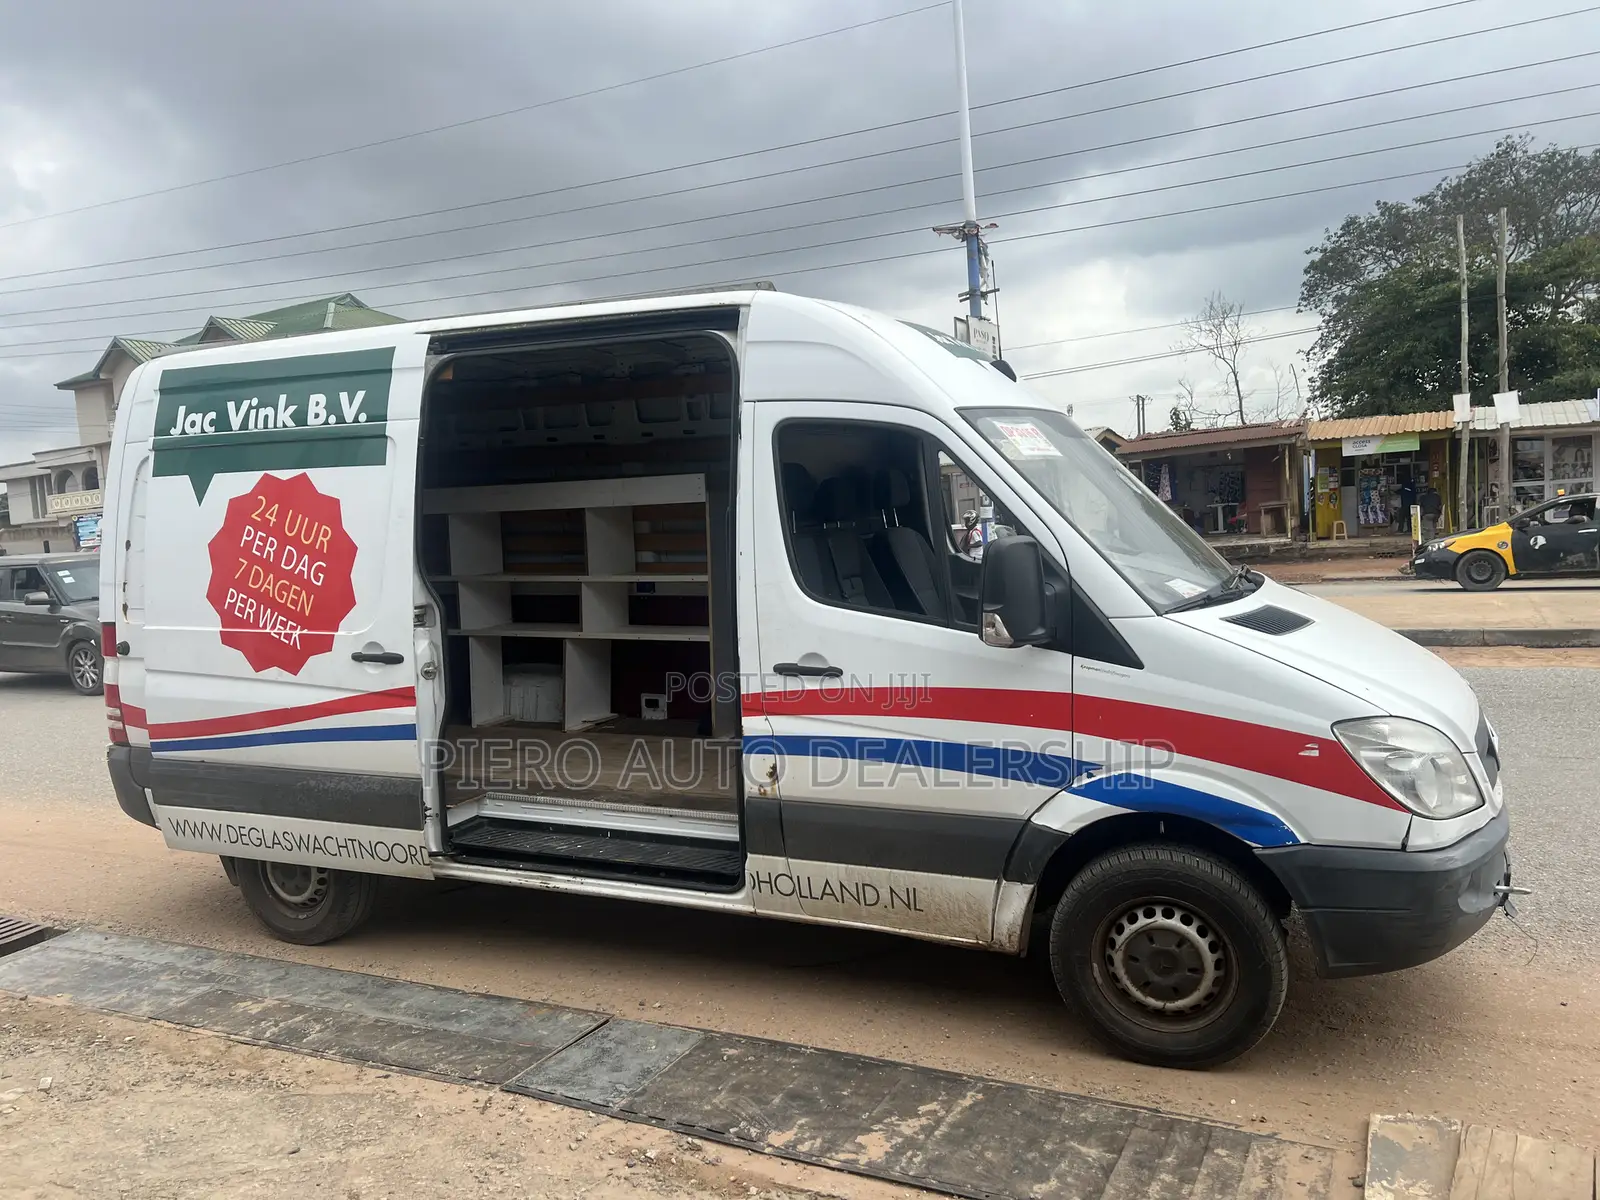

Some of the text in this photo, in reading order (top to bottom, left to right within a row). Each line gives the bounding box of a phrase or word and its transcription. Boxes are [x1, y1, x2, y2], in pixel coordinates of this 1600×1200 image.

[169, 390, 368, 436] Jac Vink B.V.
[251, 495, 332, 553] 24 UUR
[240, 525, 327, 586] PER DAG
[234, 557, 314, 617] 7 DAGEN
[224, 587, 308, 650] PER WEEK
[749, 870, 924, 912] HOLLAND.NL
